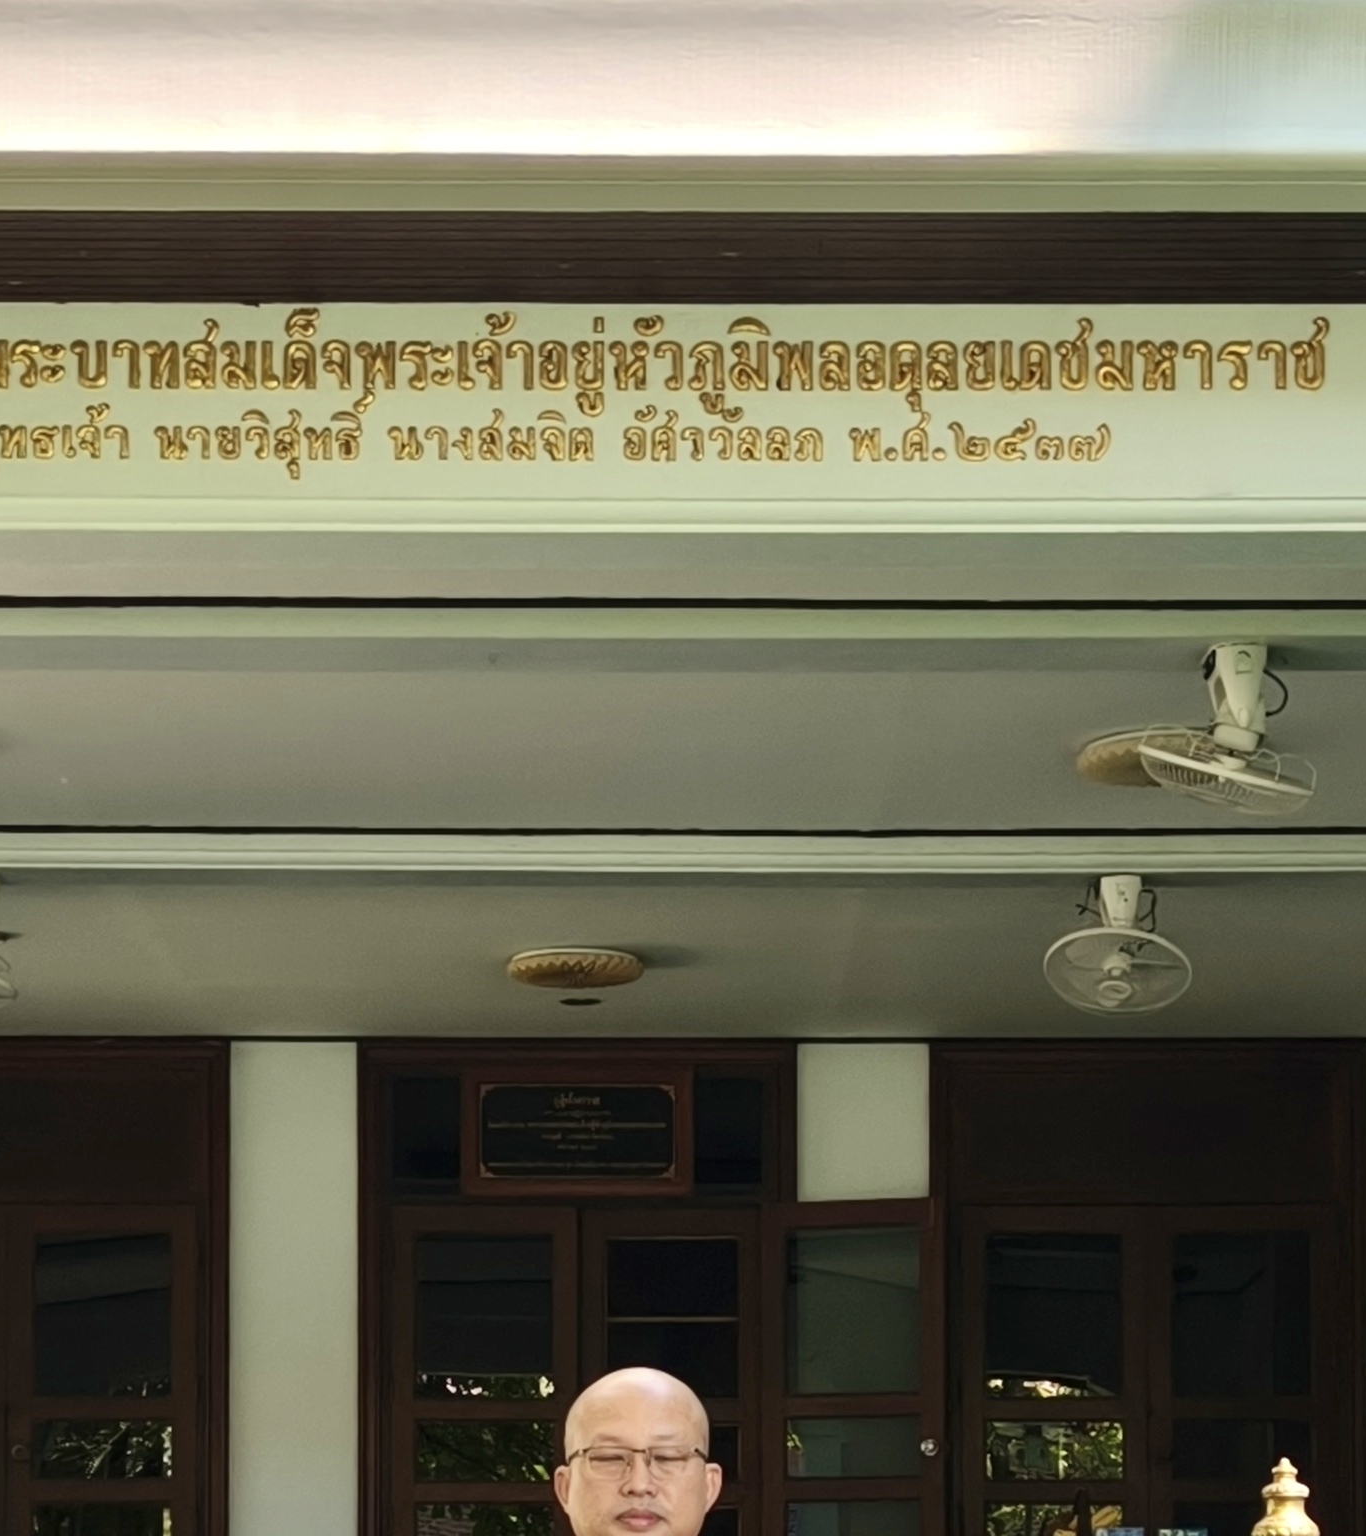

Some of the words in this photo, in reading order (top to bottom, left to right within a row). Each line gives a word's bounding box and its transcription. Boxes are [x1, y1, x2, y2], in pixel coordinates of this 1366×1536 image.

[153, 391, 375, 480] นายวิสุทธิ์
[386, 408, 595, 462] นางสมจิต
